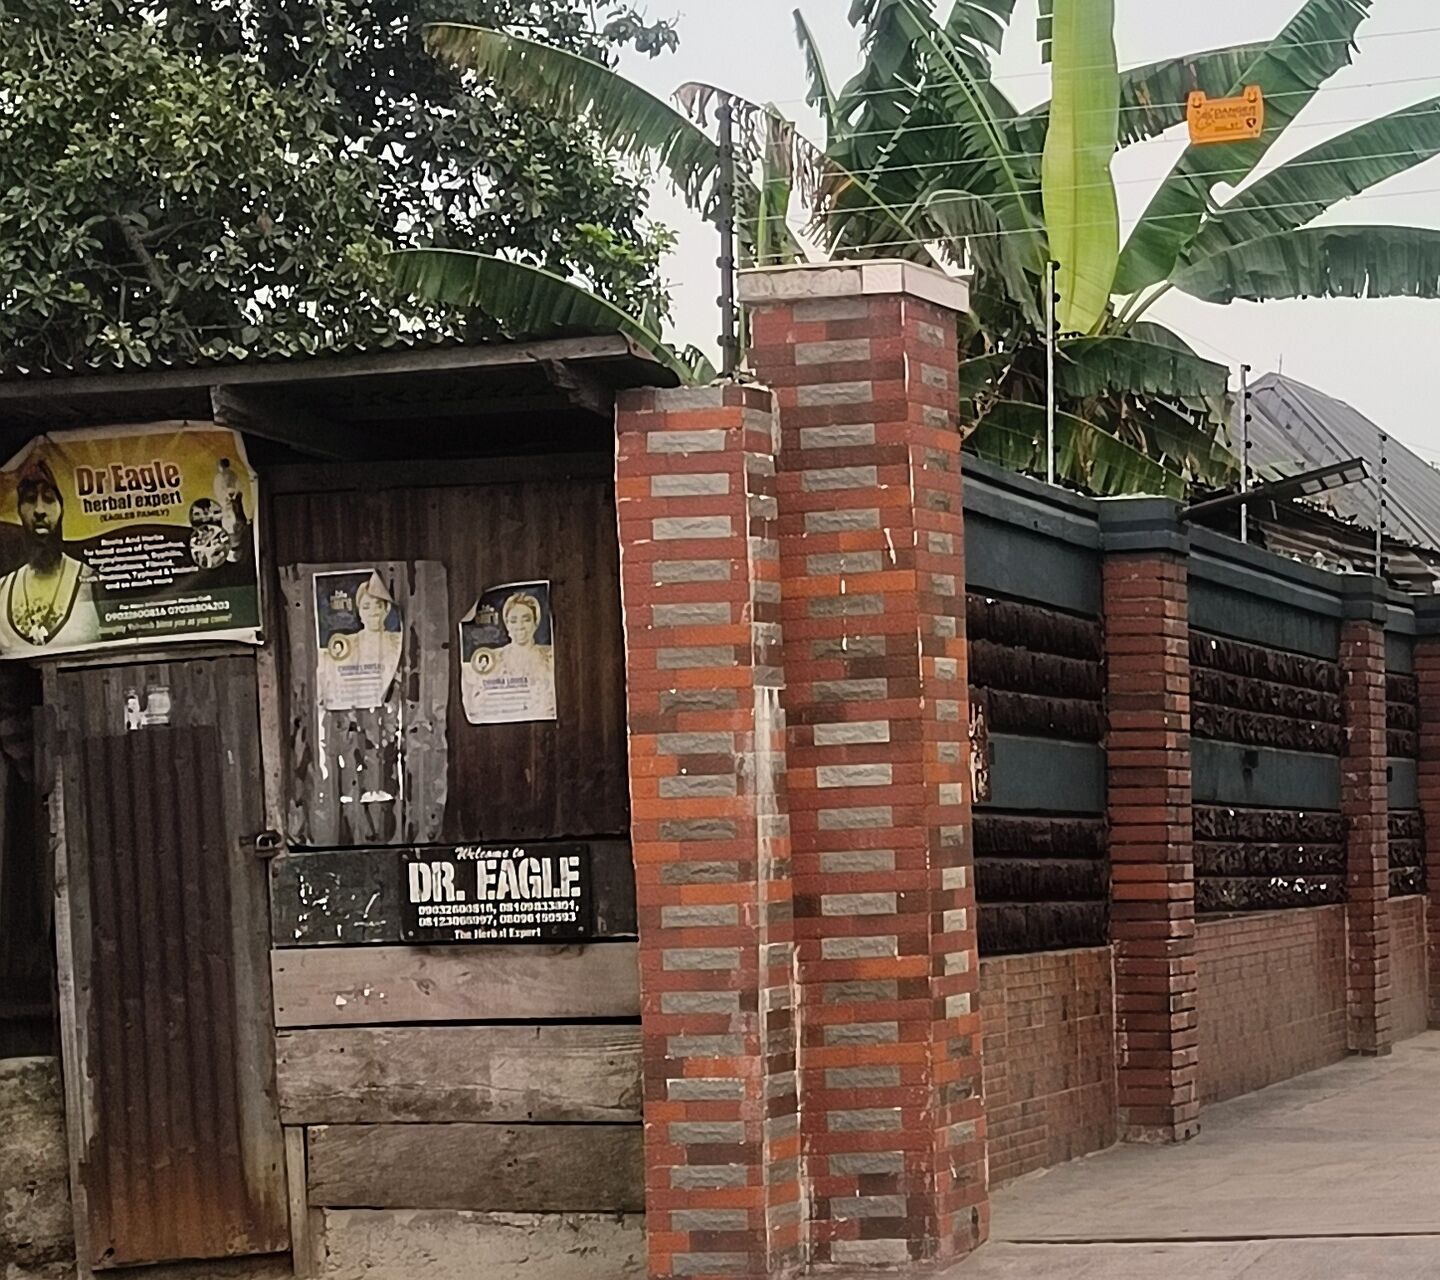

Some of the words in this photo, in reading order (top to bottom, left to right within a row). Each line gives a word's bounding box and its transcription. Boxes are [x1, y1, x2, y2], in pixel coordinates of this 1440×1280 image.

[76, 467, 106, 496] Dr
[111, 461, 180, 493] Eagle
[83, 494, 131, 513] herbal
[135, 491, 182, 508] expert
[454, 846, 509, 861] Welcome
[512, 847, 525, 858] to
[408, 861, 465, 903] DR.
[476, 856, 581, 901] EAGLE
[454, 929, 472, 939] The
[474, 927, 507, 939] Herbal
[508, 926, 541, 939] Expert
